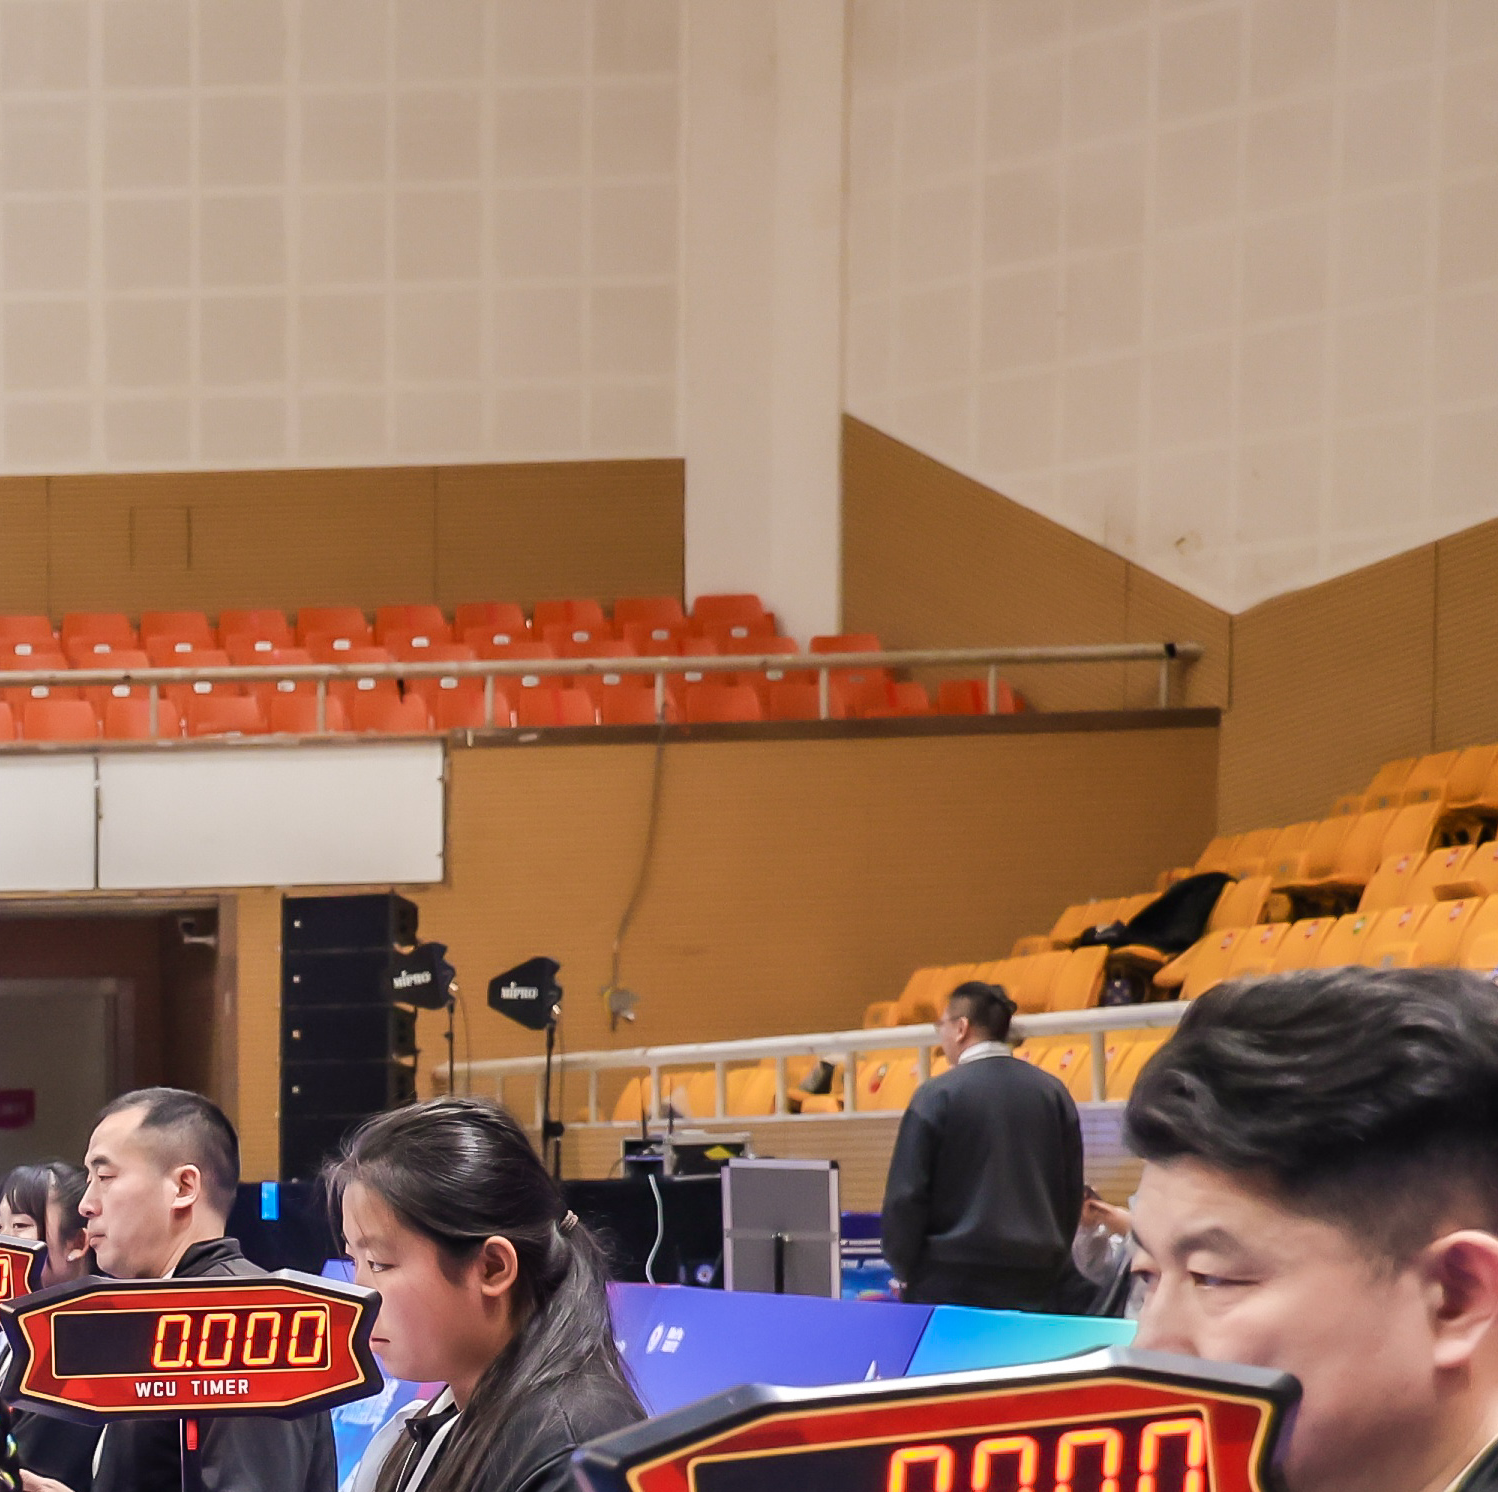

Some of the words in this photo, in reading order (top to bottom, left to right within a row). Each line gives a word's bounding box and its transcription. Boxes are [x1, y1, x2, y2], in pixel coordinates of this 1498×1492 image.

[152, 1308, 329, 1369] 0.000
[135, 1379, 177, 1398] WCU
[190, 1378, 250, 1397] TIMER
